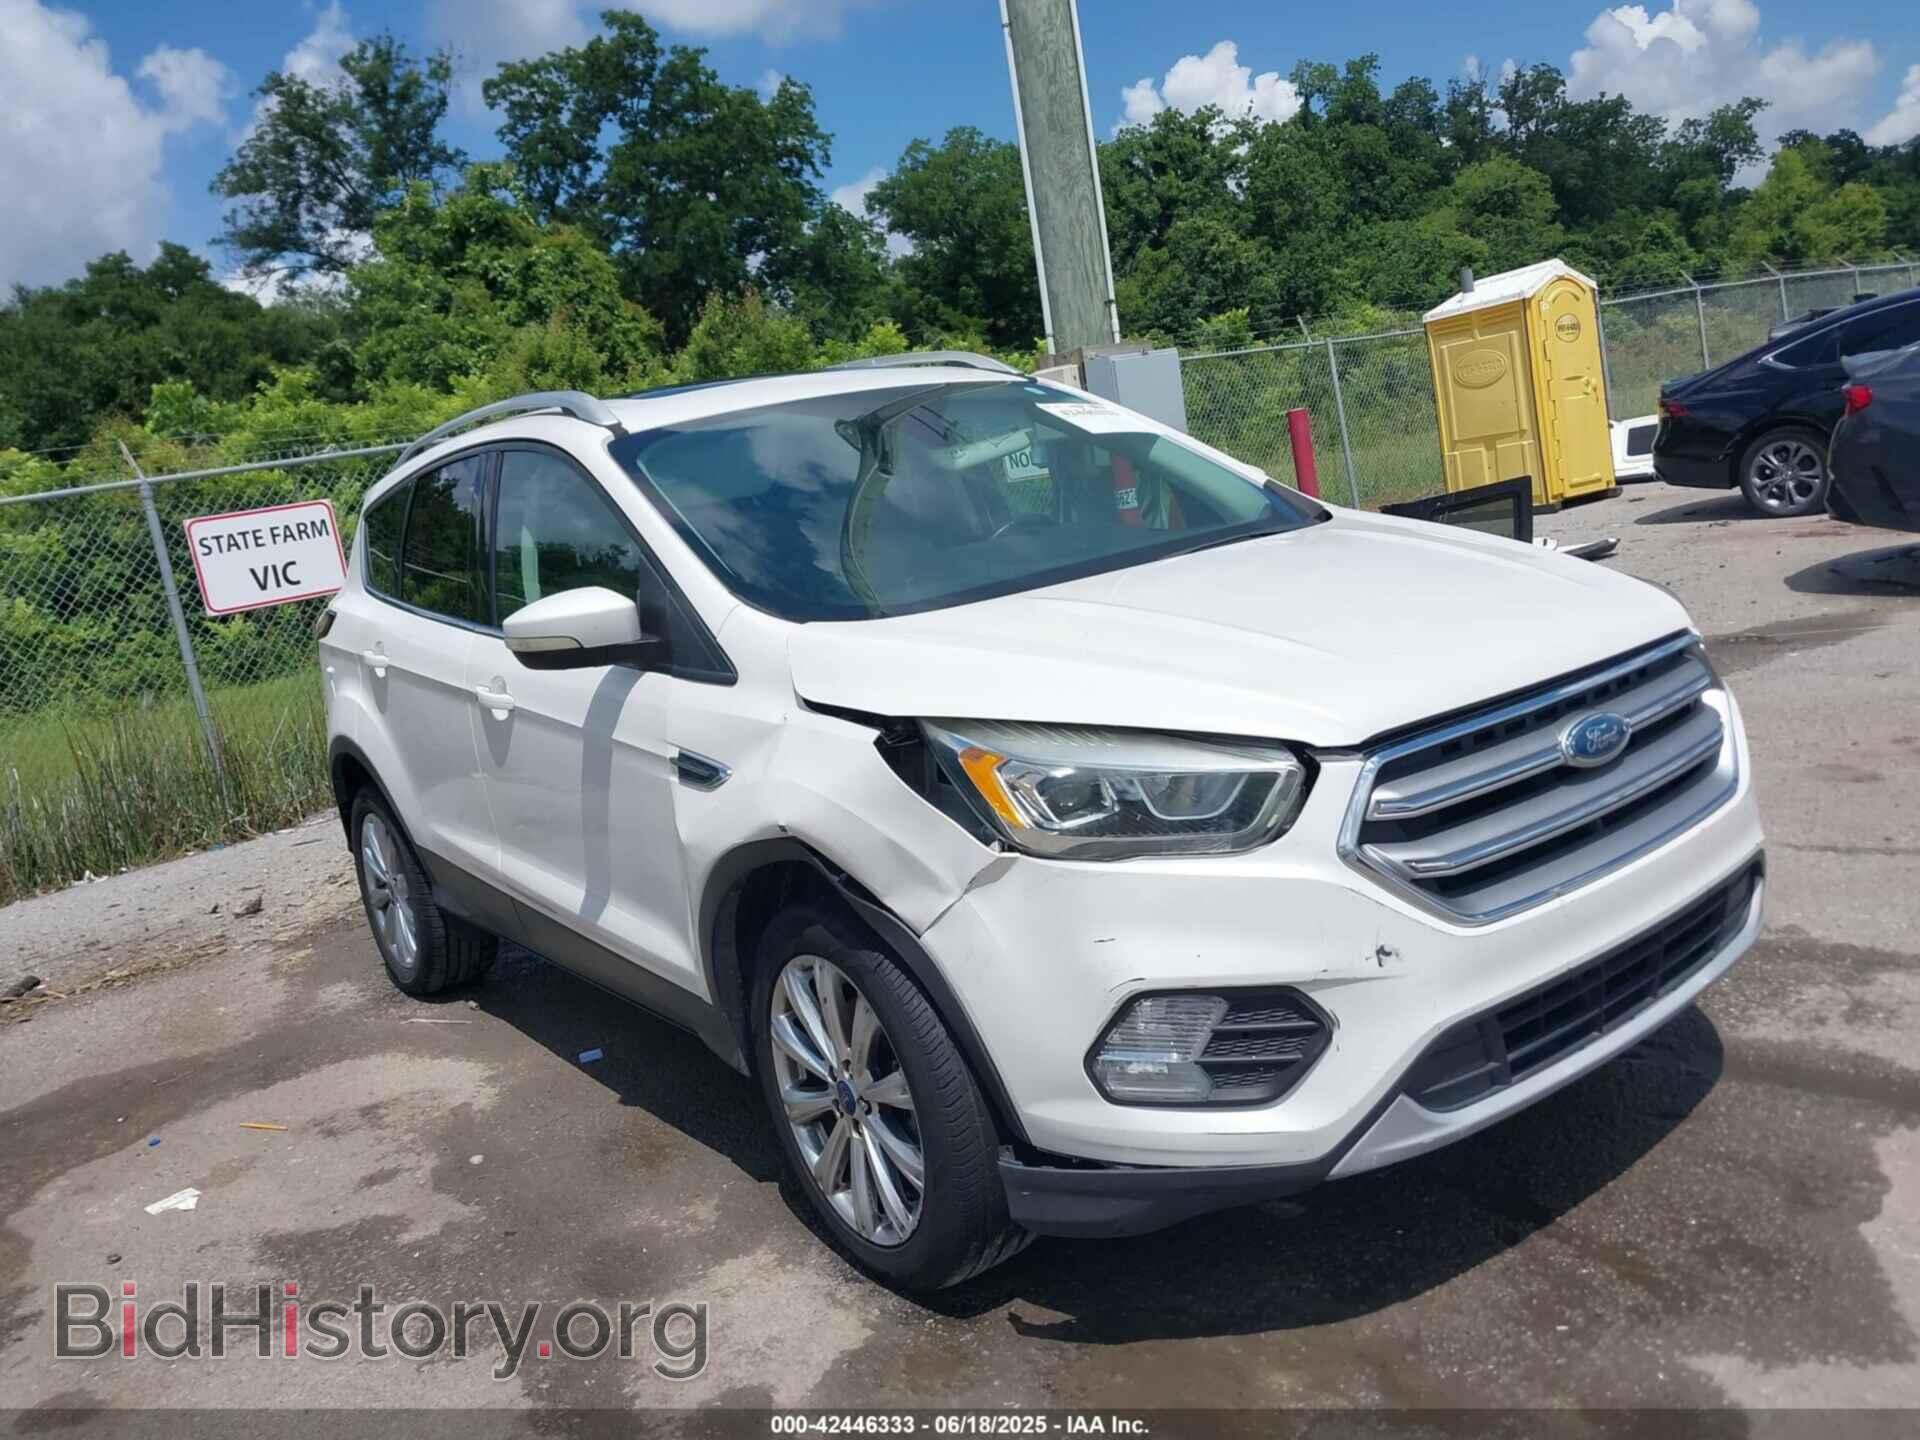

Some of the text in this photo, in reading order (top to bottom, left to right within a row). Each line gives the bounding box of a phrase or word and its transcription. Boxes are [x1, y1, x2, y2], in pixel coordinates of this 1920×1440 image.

[198, 518, 330, 556] STATE FARM
[249, 561, 302, 591] VIC
